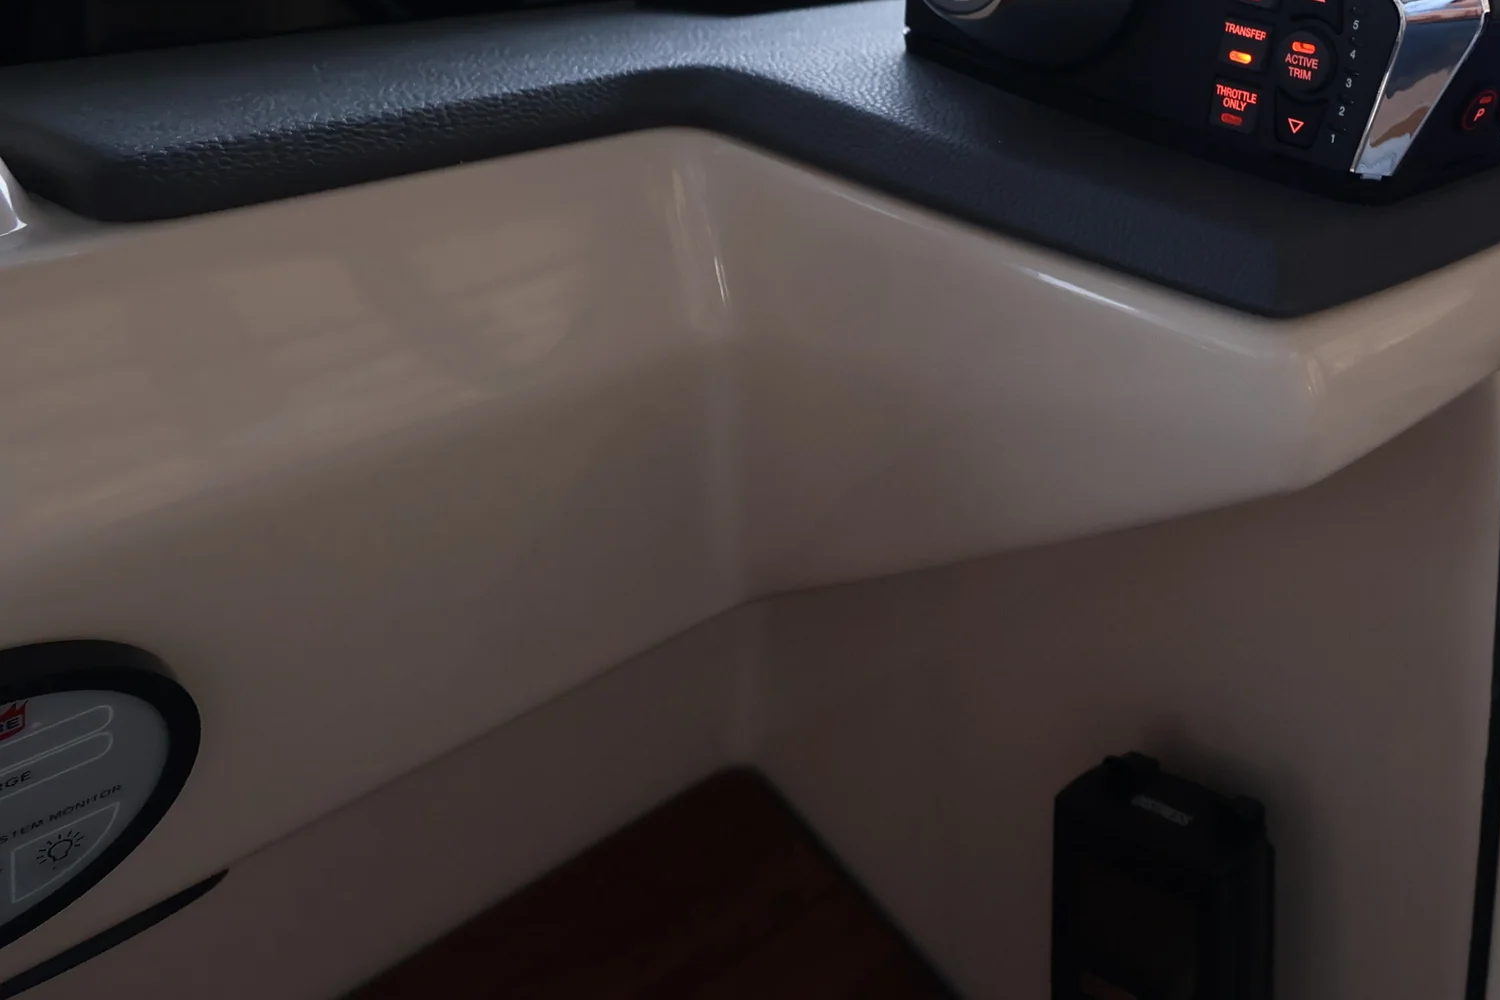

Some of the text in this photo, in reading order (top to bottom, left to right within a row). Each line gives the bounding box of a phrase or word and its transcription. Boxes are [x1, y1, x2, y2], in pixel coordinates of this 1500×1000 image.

[1352, 20, 1360, 30] 5
[1285, 53, 1320, 70] ACTIVE
[1350, 50, 1357, 60] 4
[1288, 66, 1312, 81] TRIM
[1345, 78, 1352, 88] 3
[1216, 84, 1258, 104] THROTTLE
[1222, 98, 1247, 112] ONLY
[1338, 106, 1346, 117] 2
[1473, 108, 1485, 122] P
[1330, 134, 1336, 144] 1
[49, 784, 122, 821] MONITOR
